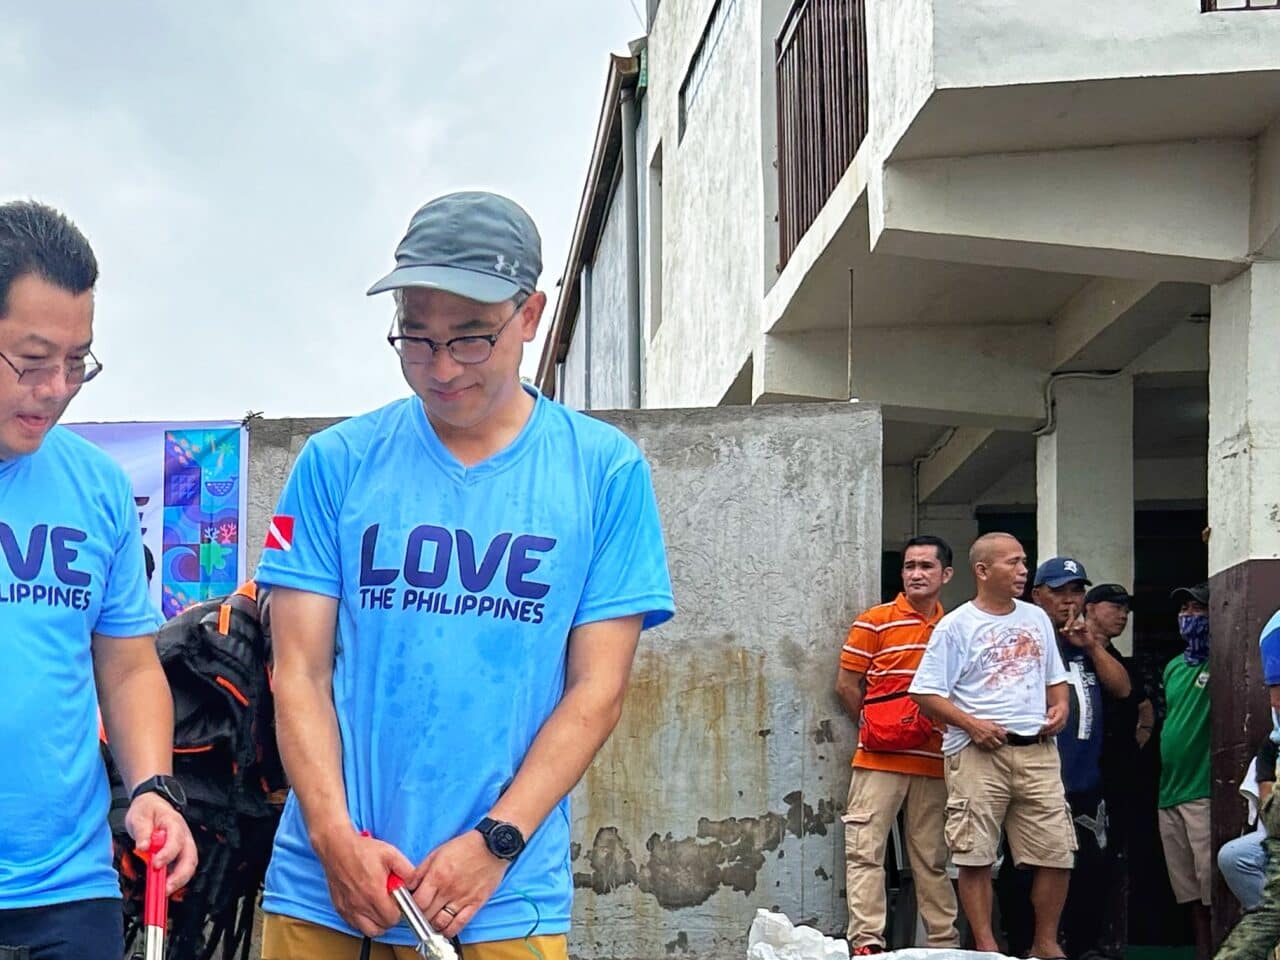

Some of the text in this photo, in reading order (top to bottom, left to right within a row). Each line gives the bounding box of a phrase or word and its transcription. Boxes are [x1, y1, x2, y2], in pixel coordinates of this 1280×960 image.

[360, 523, 557, 600] LOVE
[360, 588, 545, 624] THE PHILIPPINES
